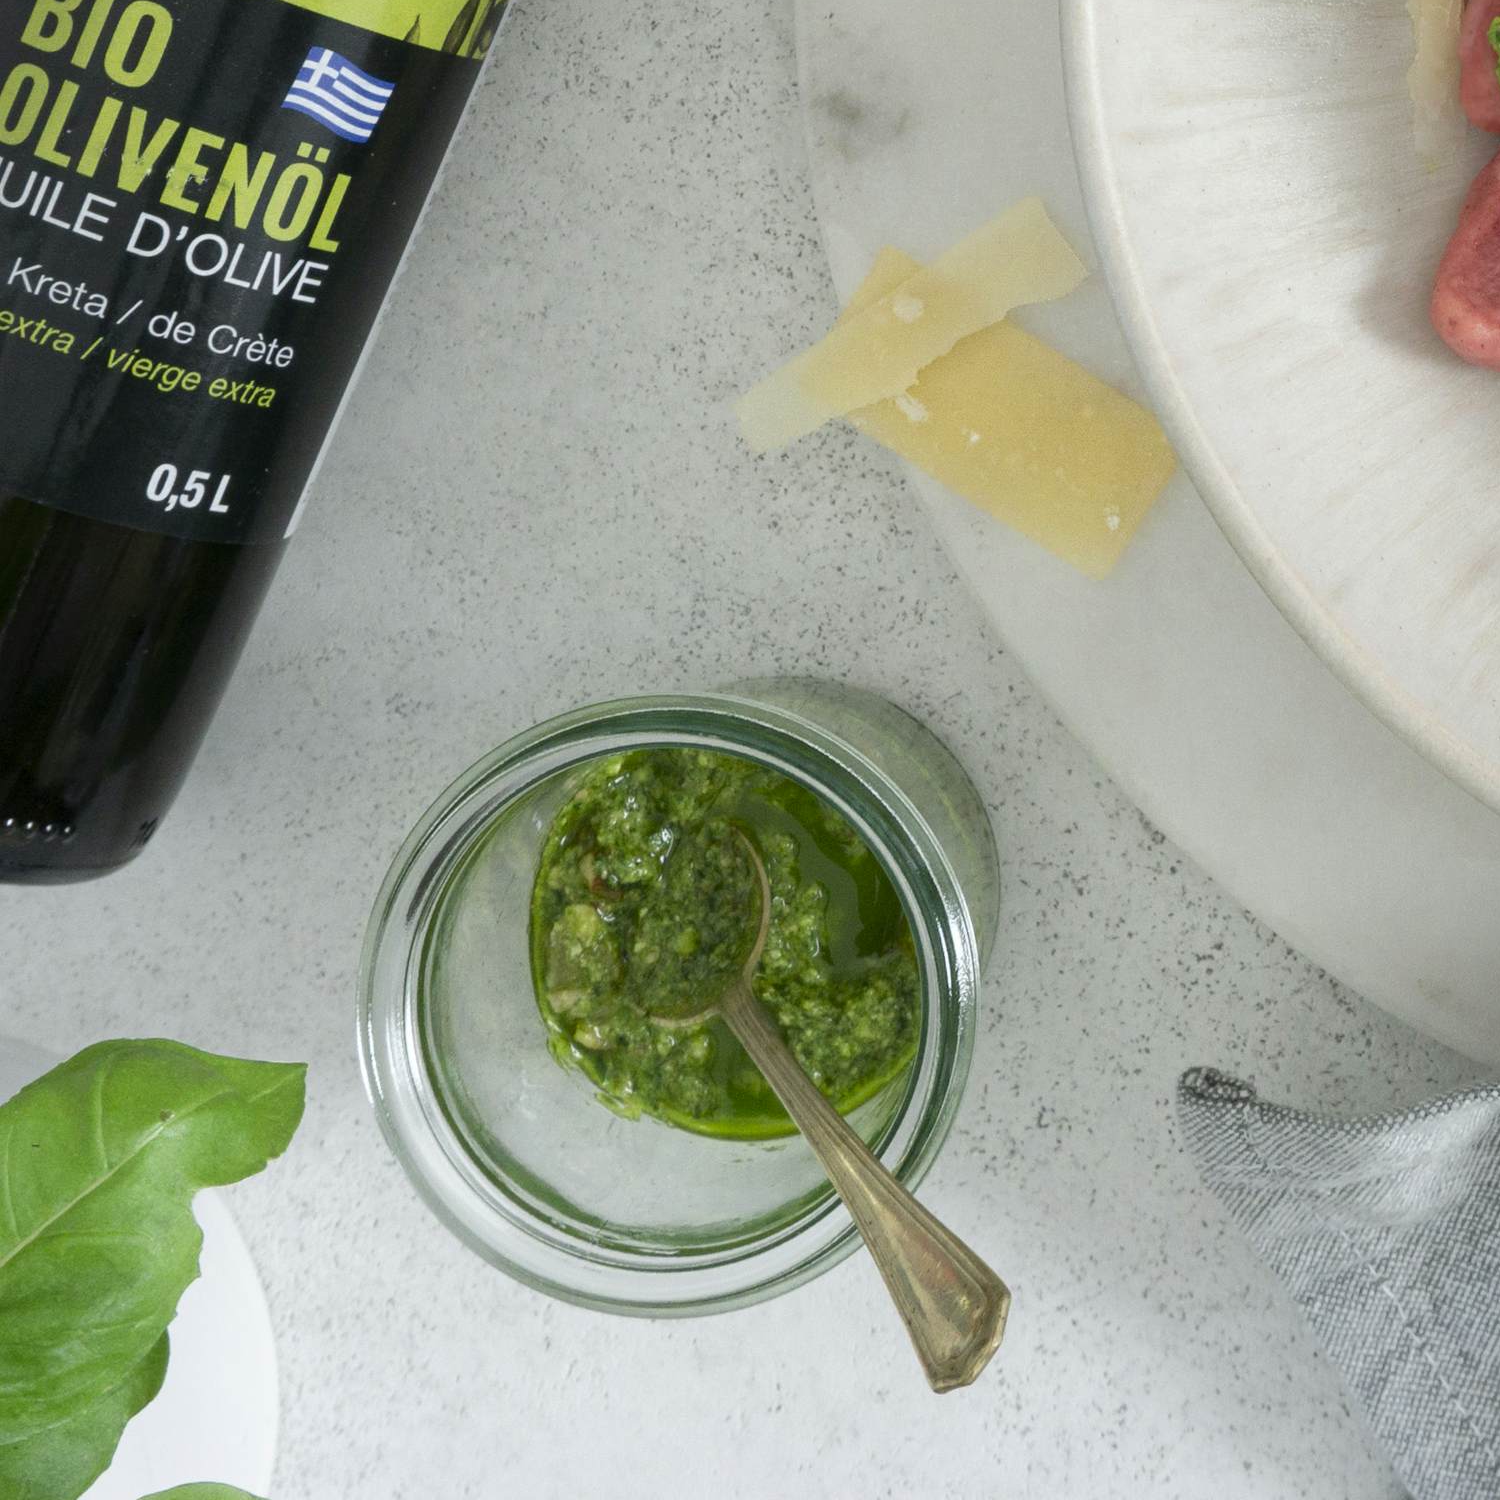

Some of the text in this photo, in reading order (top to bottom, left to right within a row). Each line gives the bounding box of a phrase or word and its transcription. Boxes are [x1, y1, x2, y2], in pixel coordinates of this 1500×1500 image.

[0, 63, 352, 252] OLIVENÖL
[0, 156, 329, 304] UILE D'OLIVE
[0, 311, 276, 407] extra / vierge extra
[8, 257, 294, 367] Kreta / de Crète
[146, 464, 230, 512] 0,5 L
